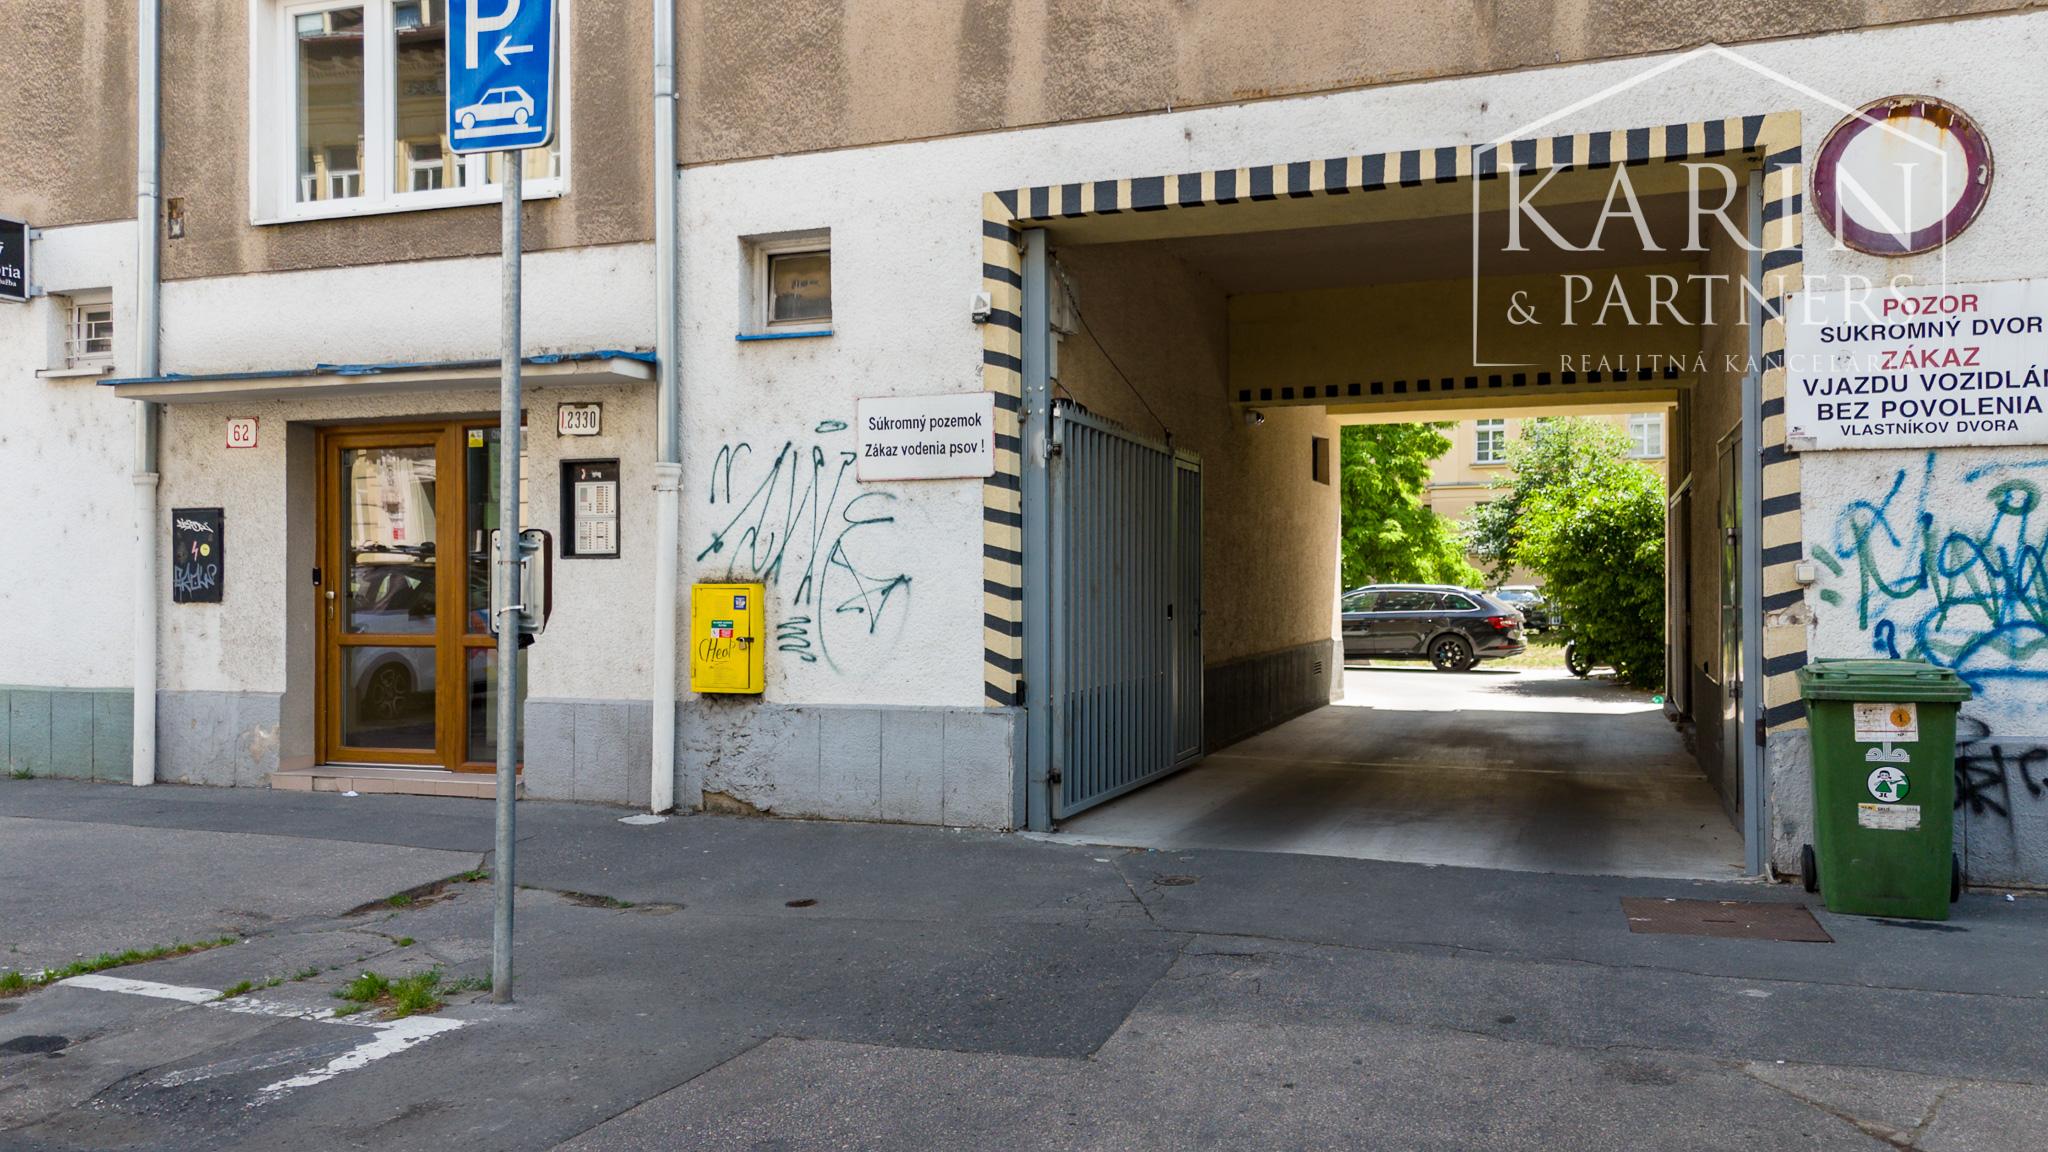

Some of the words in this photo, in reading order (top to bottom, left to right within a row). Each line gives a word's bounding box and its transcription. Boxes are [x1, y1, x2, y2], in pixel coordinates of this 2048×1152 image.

[465, 0, 521, 69] P
[0, 264, 21, 279] ria
[1882, 293, 1979, 317] POZOR
[1820, 315, 1961, 343] SÚKROMNÝ
[1972, 316, 2043, 336] DVOR
[1881, 344, 1981, 371] ZÁKAZ
[1802, 374, 1909, 397] VJAZDU
[1817, 401, 1870, 421] BEZ
[1881, 395, 2043, 419] POVOLENIA
[233, 424, 249, 441] 62
[868, 414, 927, 433] Súkromný
[929, 412, 982, 431] pozemok
[1840, 419, 1950, 437] VLASTNÍKOV
[1957, 419, 2019, 433] DVORA
[864, 442, 898, 457] Zákaz
[901, 441, 946, 456] vodenia
[949, 442, 978, 457] psov
[981, 438, 985, 453] !
